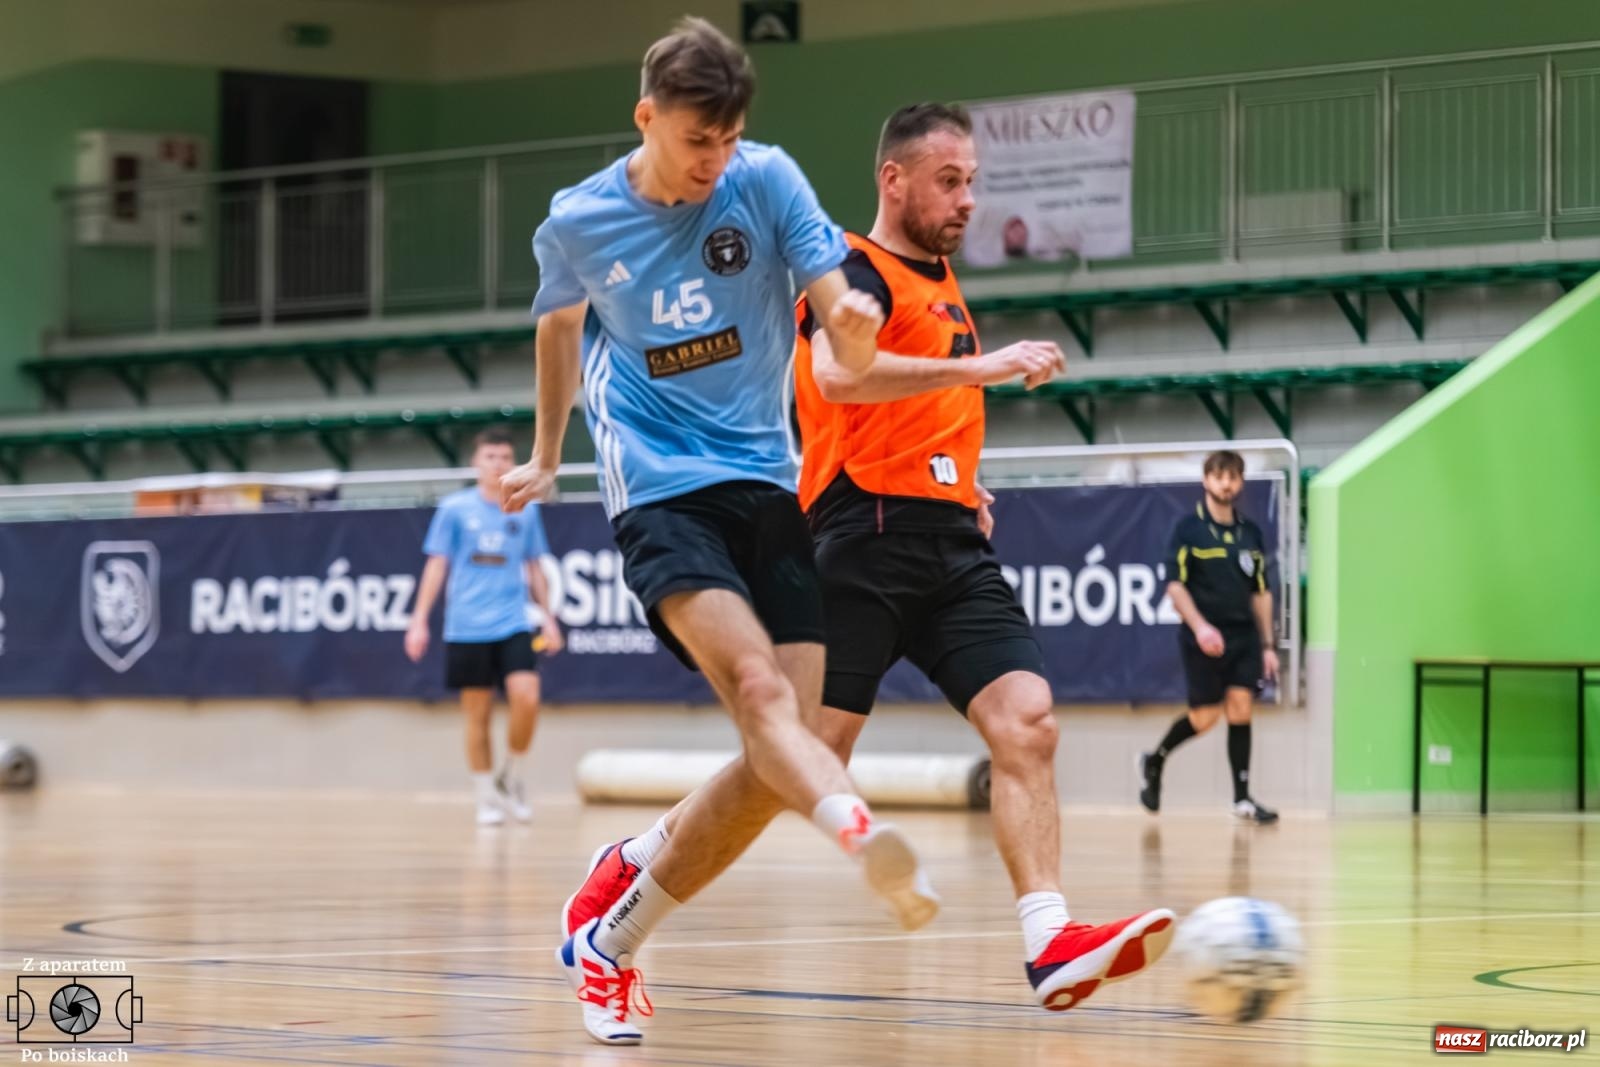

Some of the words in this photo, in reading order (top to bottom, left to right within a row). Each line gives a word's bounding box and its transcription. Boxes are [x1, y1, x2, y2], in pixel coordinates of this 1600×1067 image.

[652, 277, 713, 330] 45
[649, 332, 740, 366] GABRIEL
[929, 455, 960, 486] 10
[190, 557, 416, 634] RACIBÓRZ
